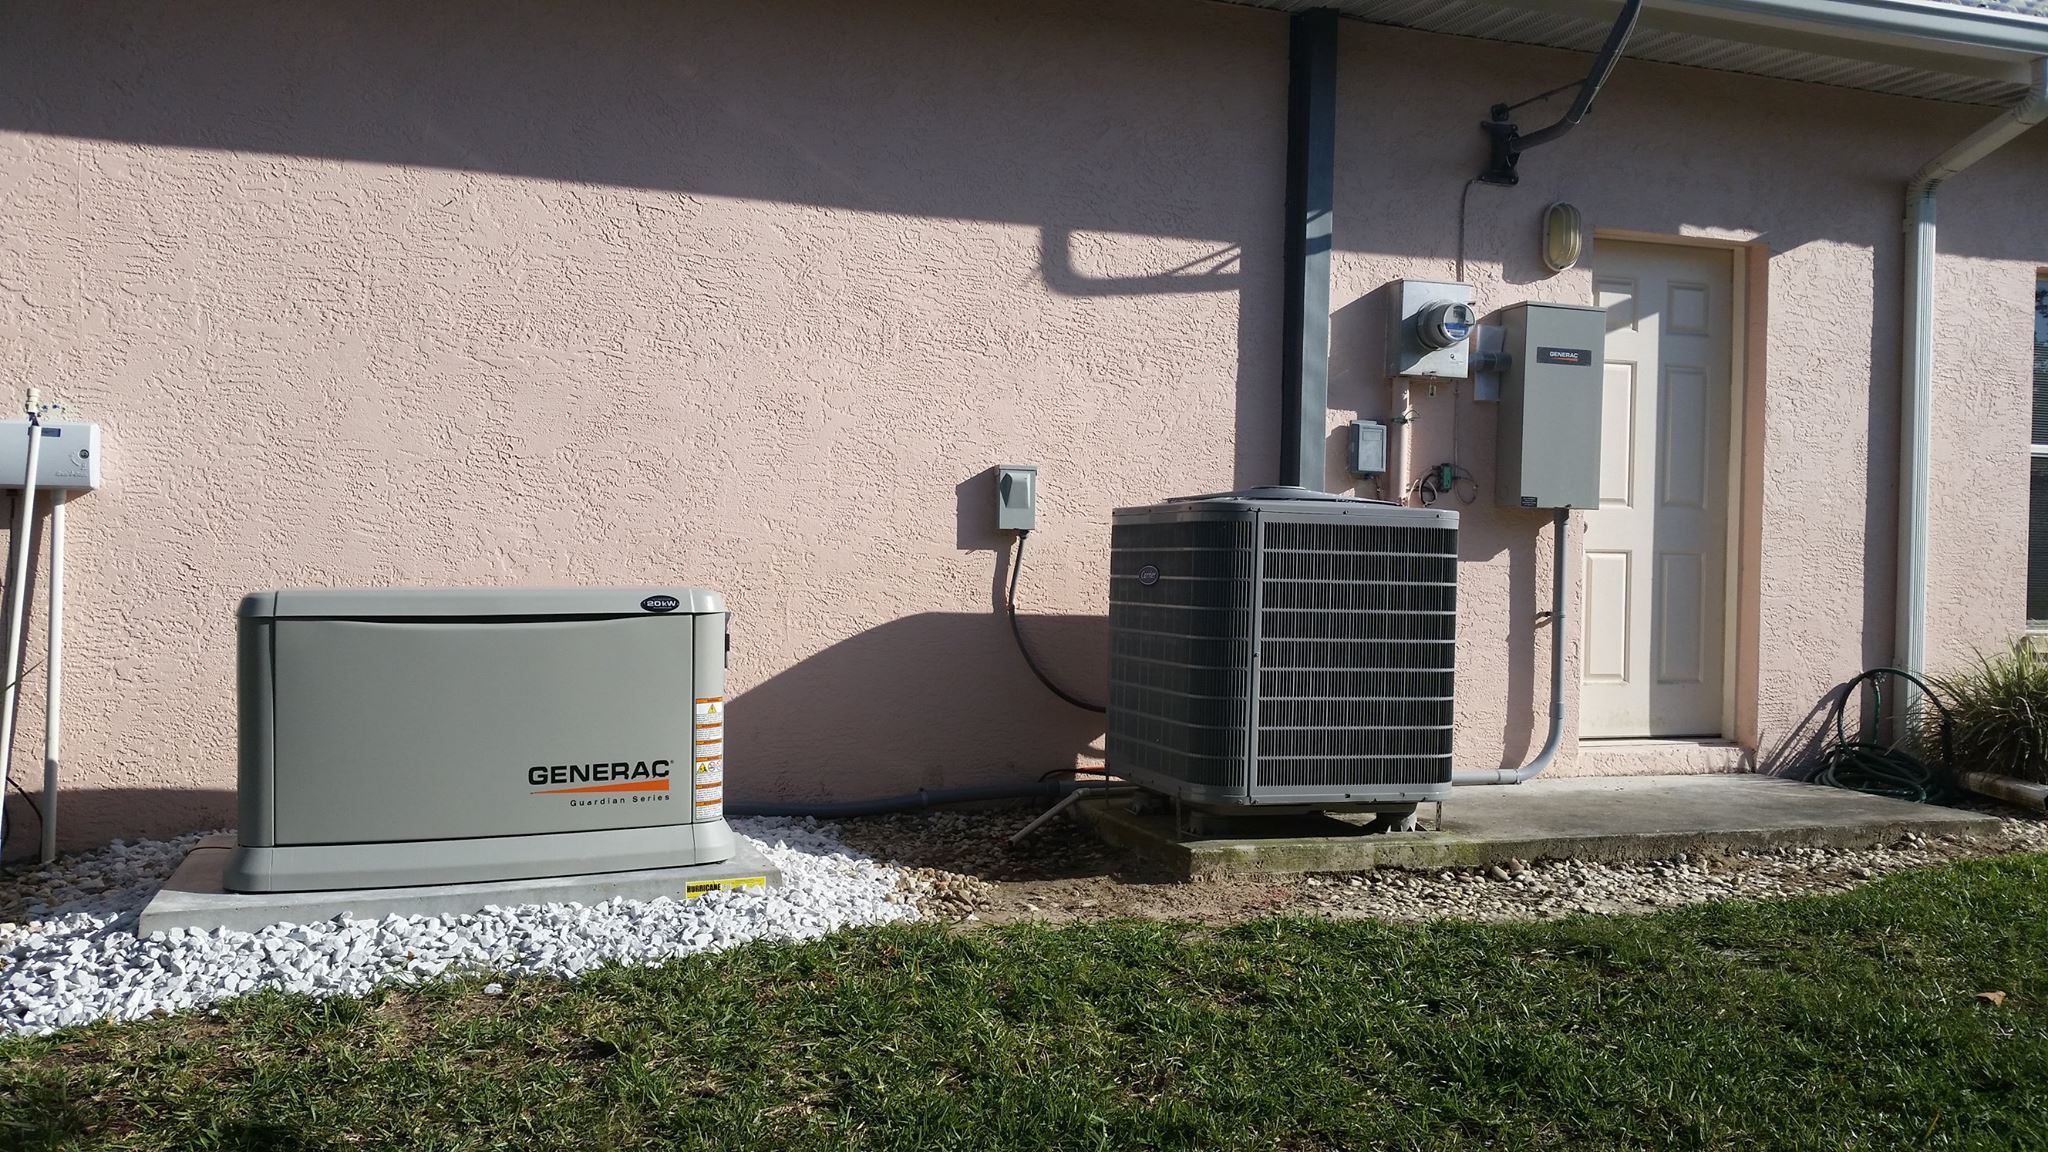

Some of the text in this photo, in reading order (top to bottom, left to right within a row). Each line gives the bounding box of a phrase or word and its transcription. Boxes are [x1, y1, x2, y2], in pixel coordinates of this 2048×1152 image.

[1549, 350, 1579, 359] GENERAC
[528, 759, 670, 785] GENERAC
[570, 793, 671, 807] Guardian Series
